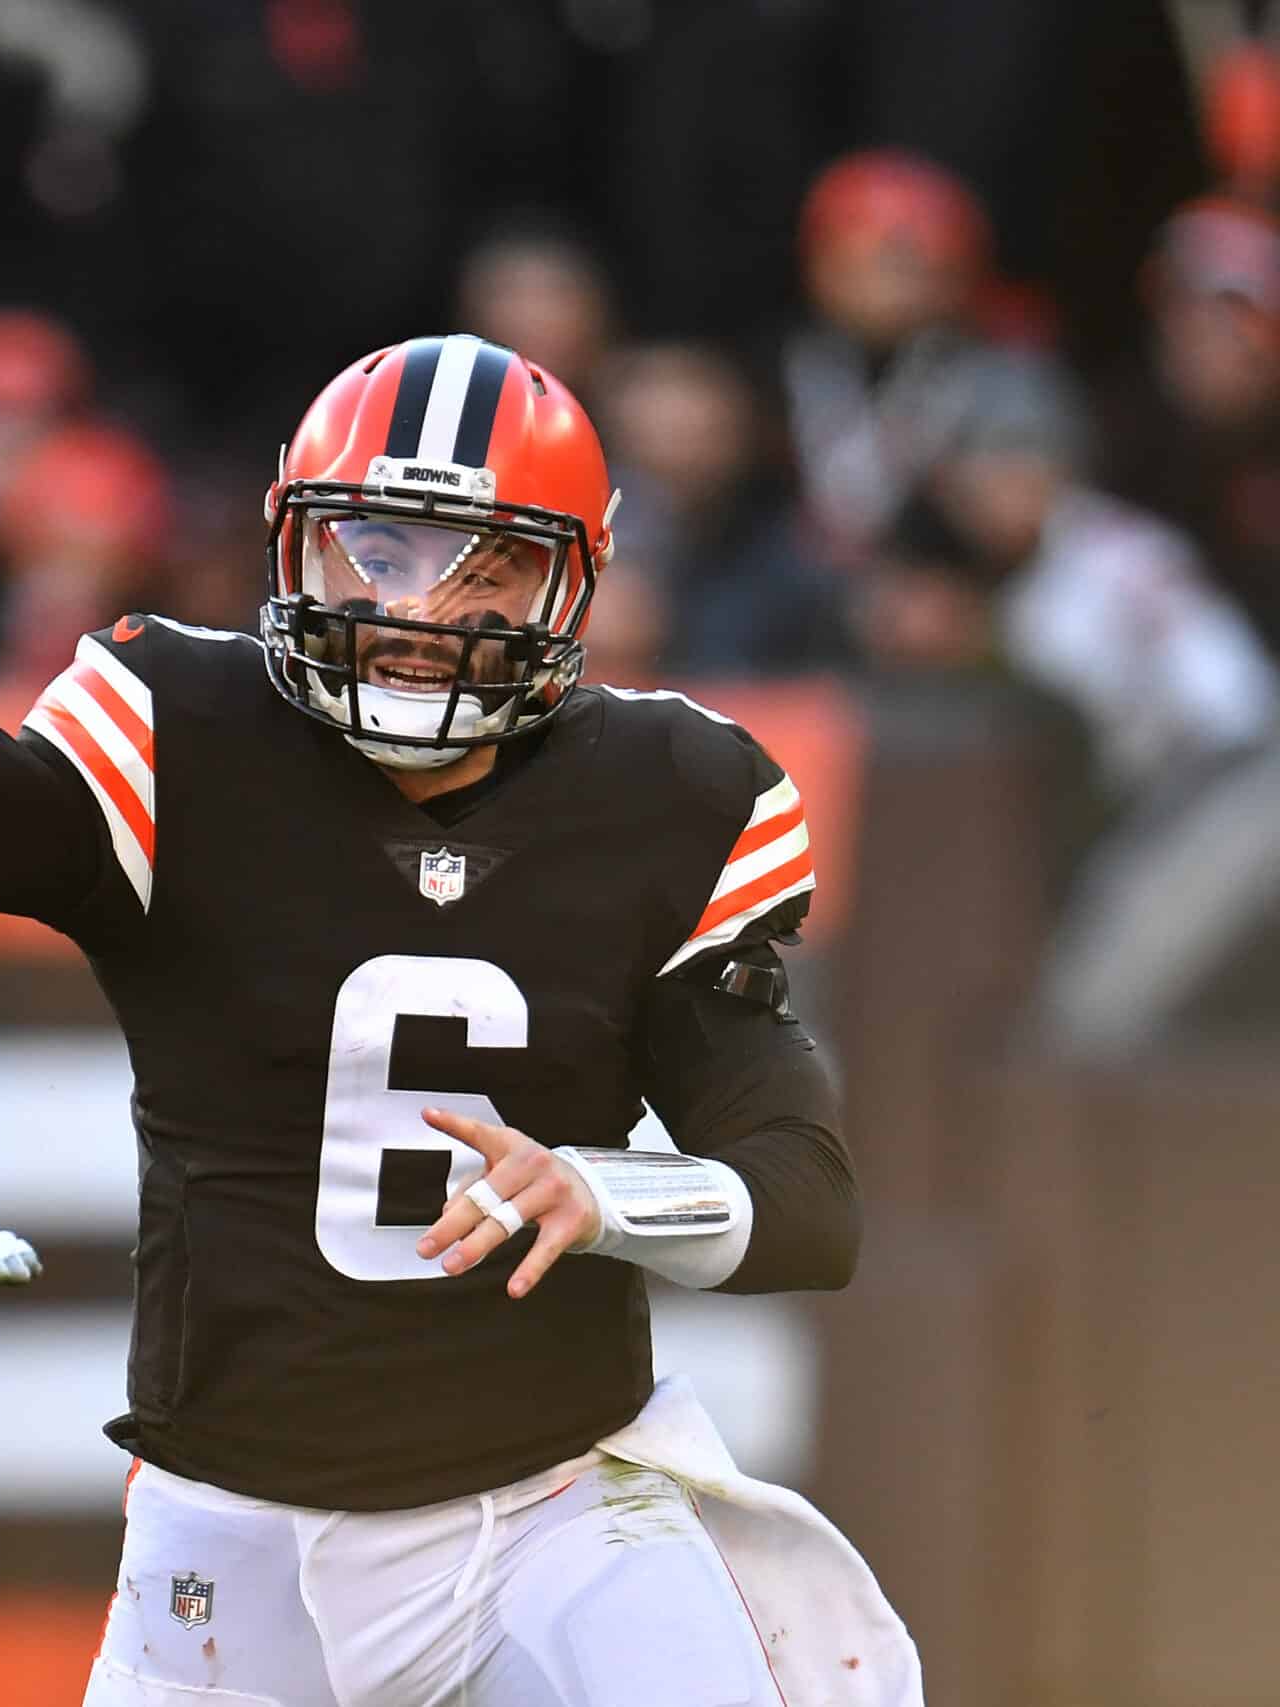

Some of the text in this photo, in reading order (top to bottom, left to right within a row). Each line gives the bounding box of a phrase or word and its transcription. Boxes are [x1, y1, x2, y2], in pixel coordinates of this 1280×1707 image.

[402, 466, 461, 487] BROWNS
[428, 878, 457, 895] NFL
[315, 954, 528, 1281] 6
[176, 1595, 204, 1618] NFL
